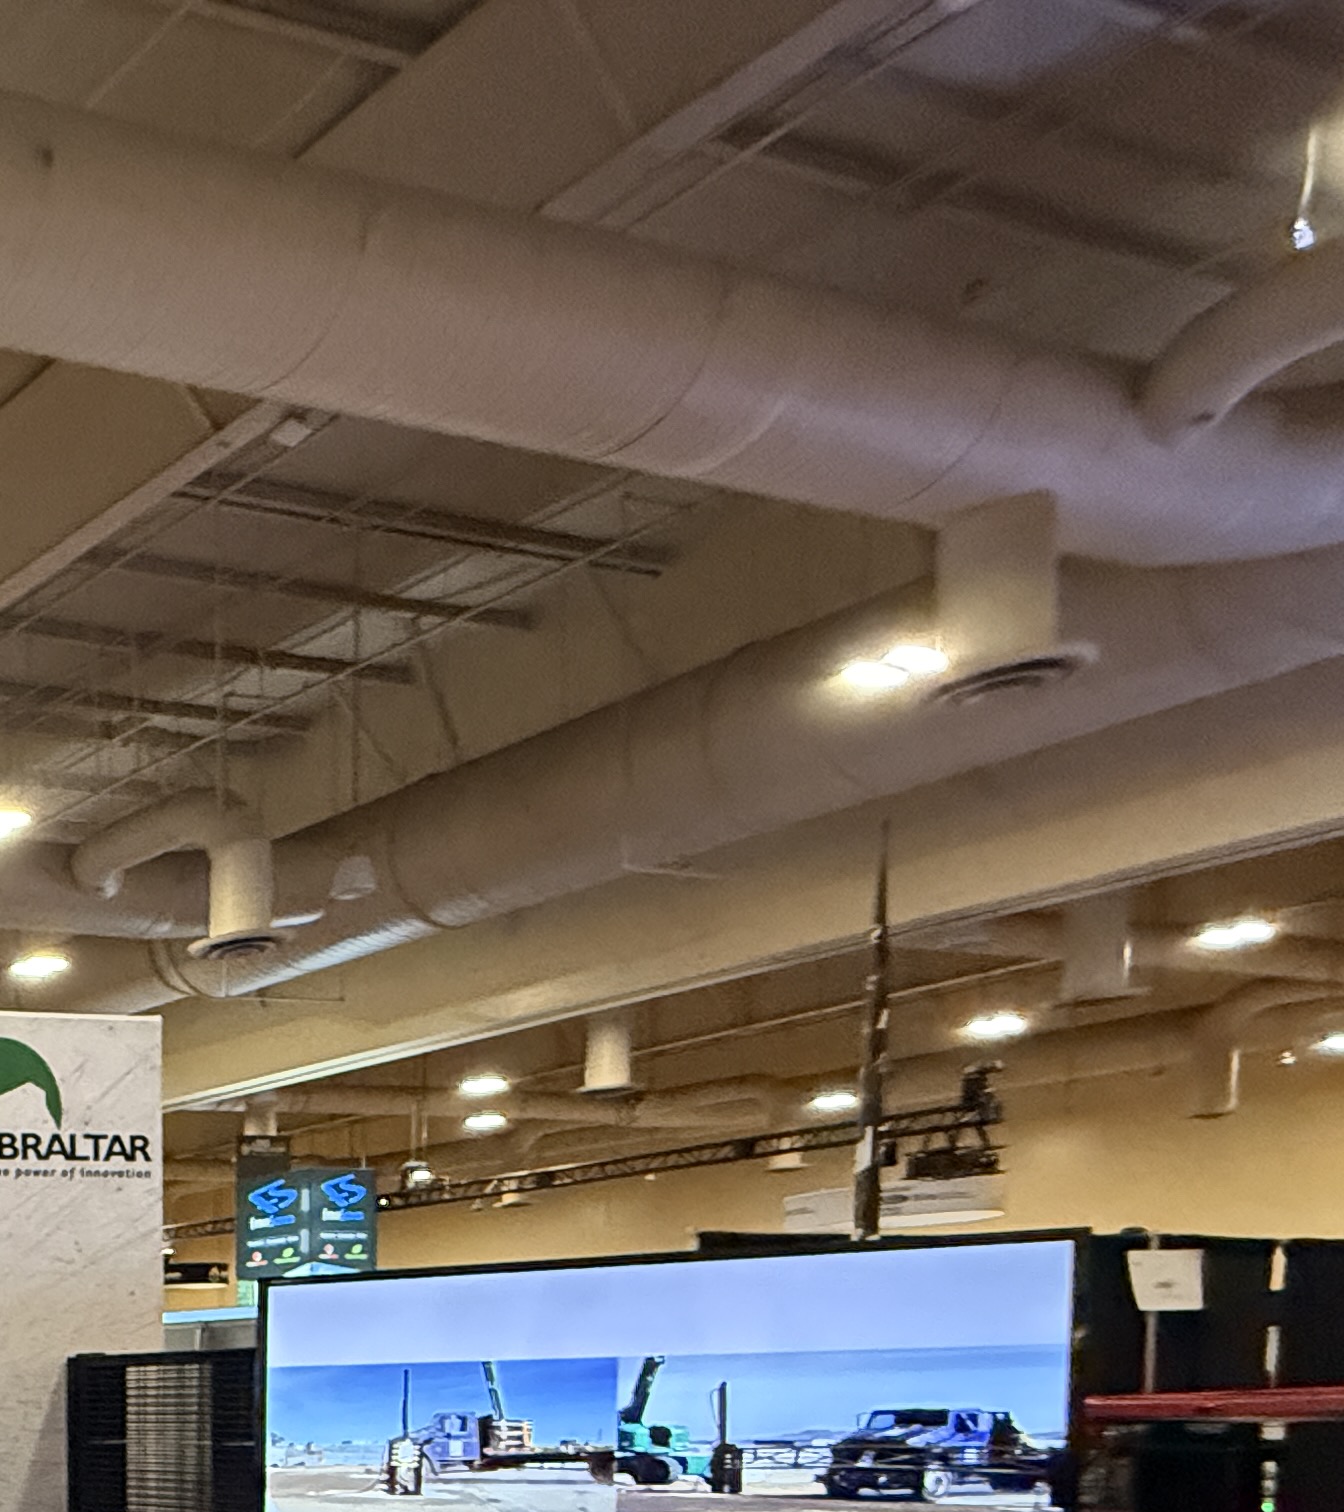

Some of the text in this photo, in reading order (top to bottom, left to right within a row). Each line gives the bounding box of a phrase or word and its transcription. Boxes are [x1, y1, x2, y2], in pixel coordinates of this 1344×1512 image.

[14, 1168, 57, 1180] power
[61, 1167, 76, 1181] of
[79, 1168, 152, 1178] innovation
